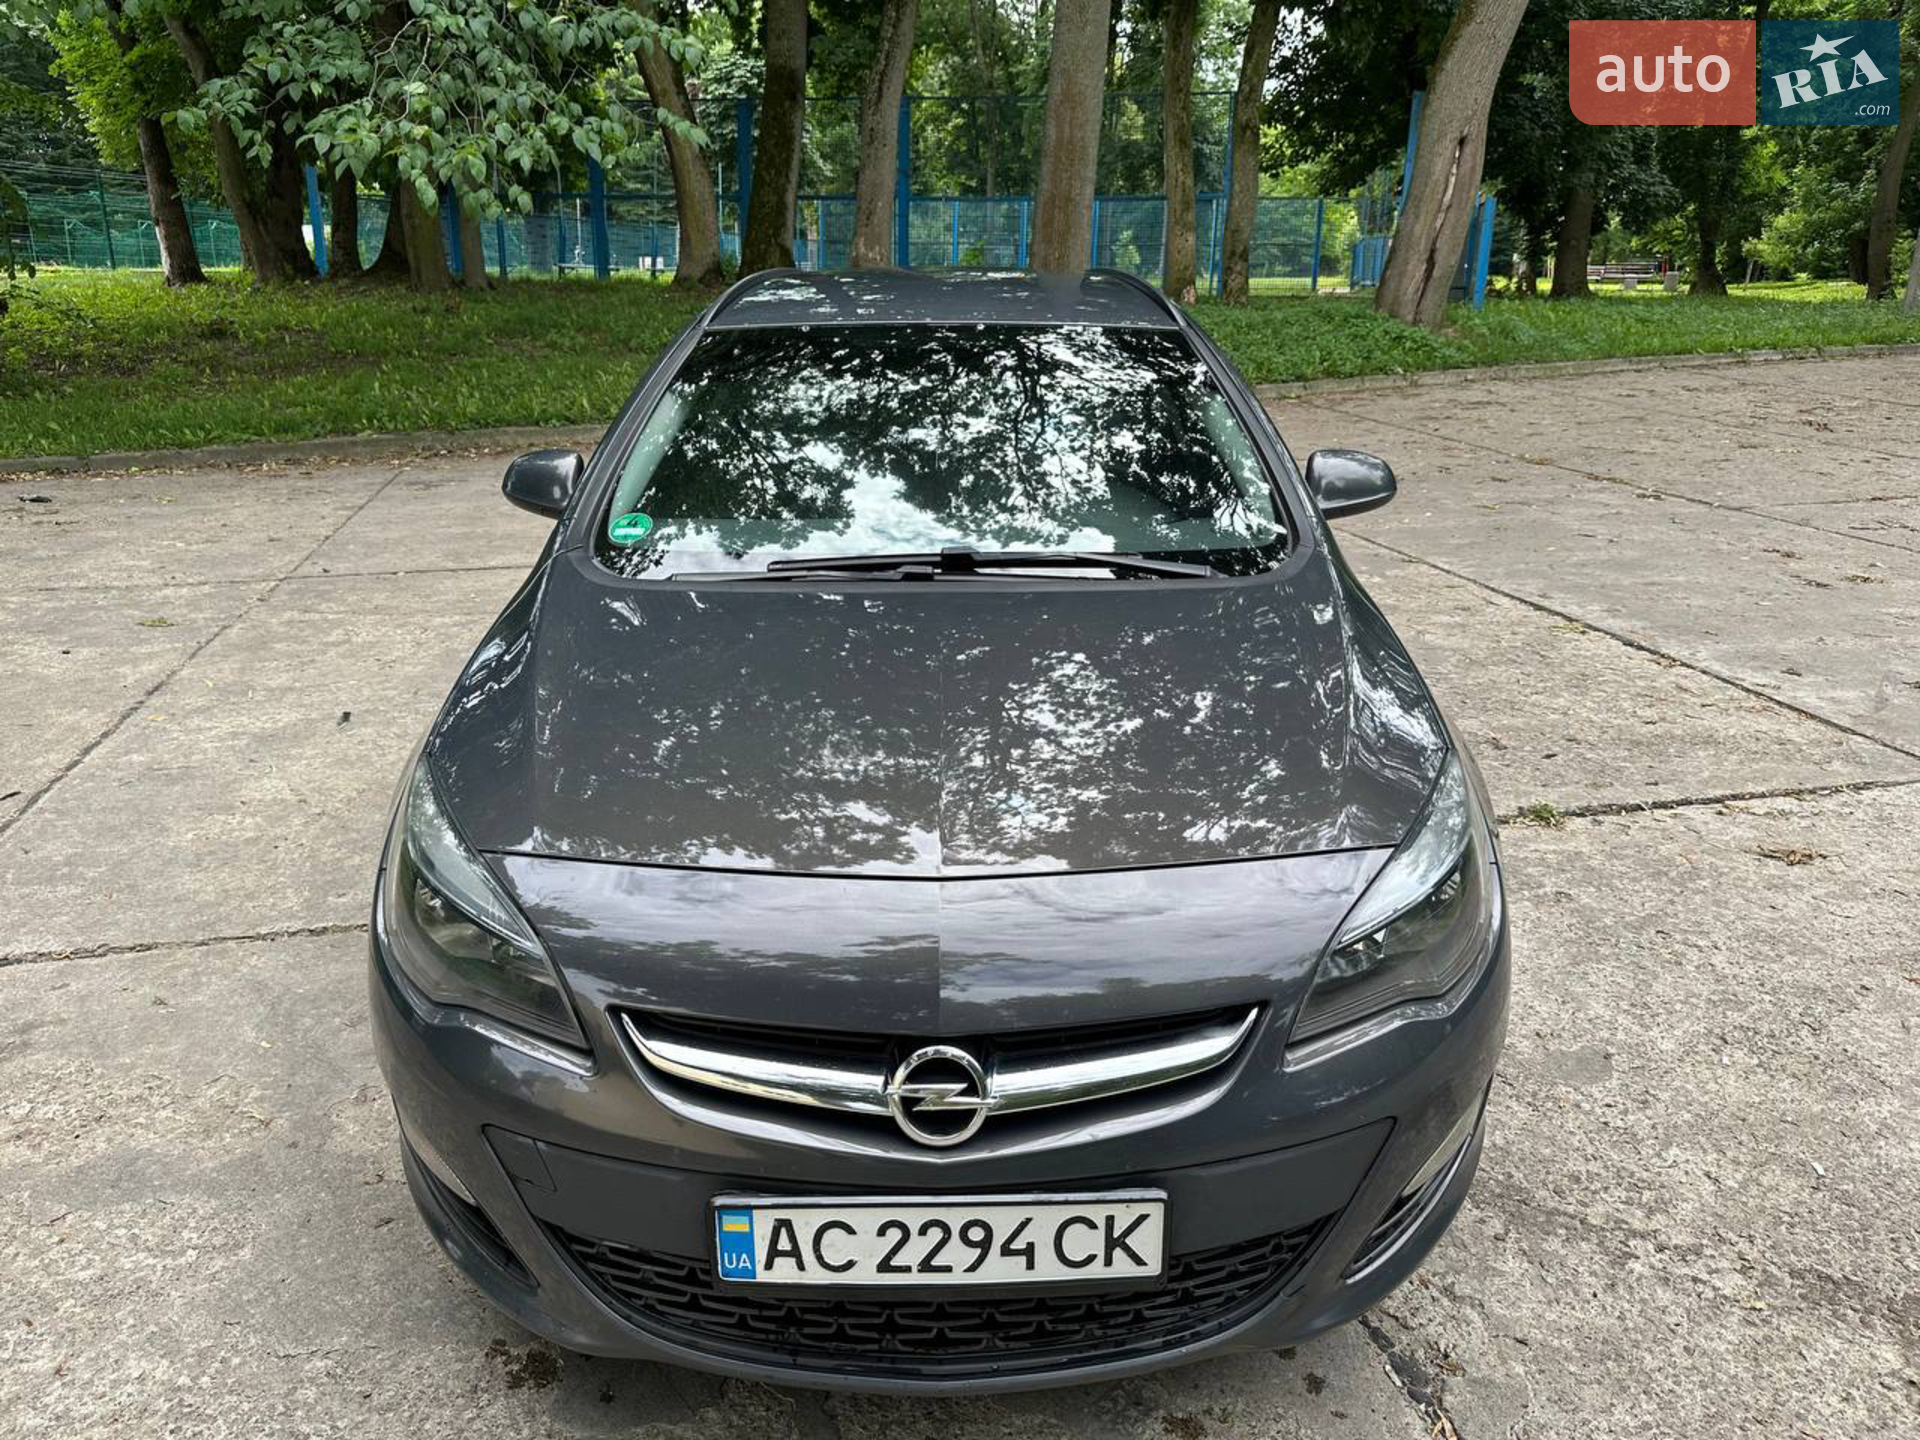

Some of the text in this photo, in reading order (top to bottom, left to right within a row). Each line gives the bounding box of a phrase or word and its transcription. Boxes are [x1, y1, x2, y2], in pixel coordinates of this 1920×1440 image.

[724, 1252, 752, 1269] UA
[763, 1213, 1151, 1274] AC 2294 CK
